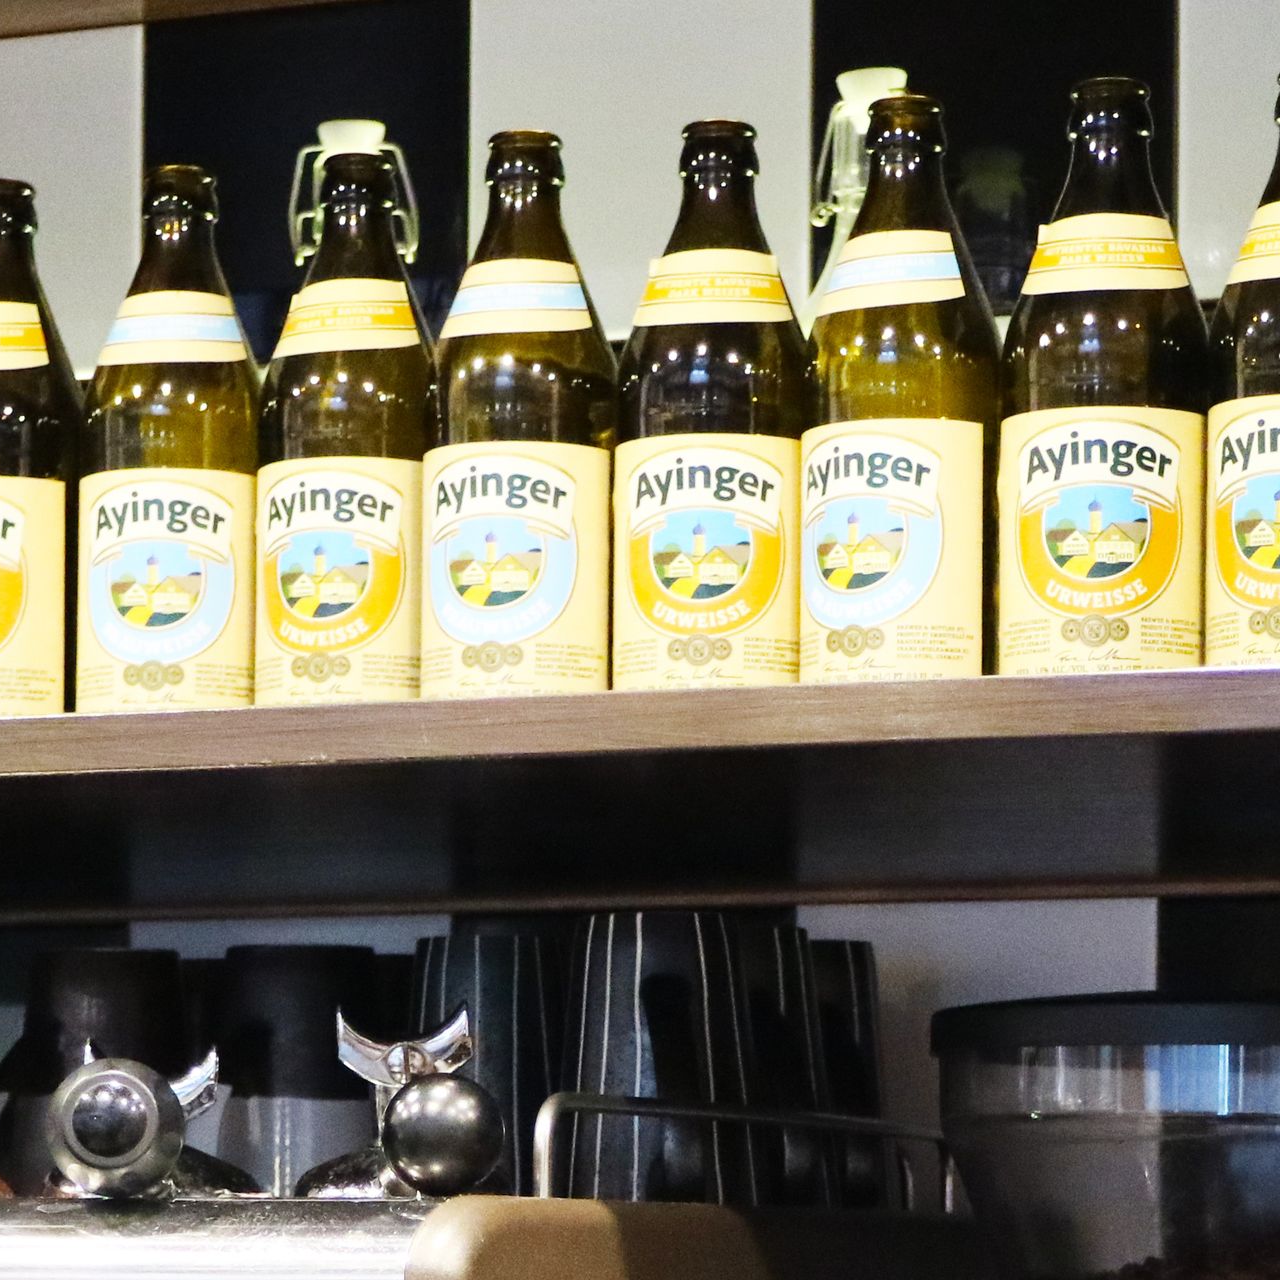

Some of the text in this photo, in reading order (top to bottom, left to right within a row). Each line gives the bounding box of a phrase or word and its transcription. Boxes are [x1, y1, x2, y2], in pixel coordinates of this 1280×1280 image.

[635, 457, 774, 508] Ayinger
[806, 446, 931, 501] Ayinger
[1026, 430, 1173, 485] Ayinger
[95, 491, 225, 540] Ayinger
[268, 481, 394, 531] Ayinger
[436, 465, 568, 517] Ayinger
[651, 599, 752, 630] URWEISSE
[1045, 577, 1149, 610] URWEISSE
[278, 616, 371, 648] URWEISSE
